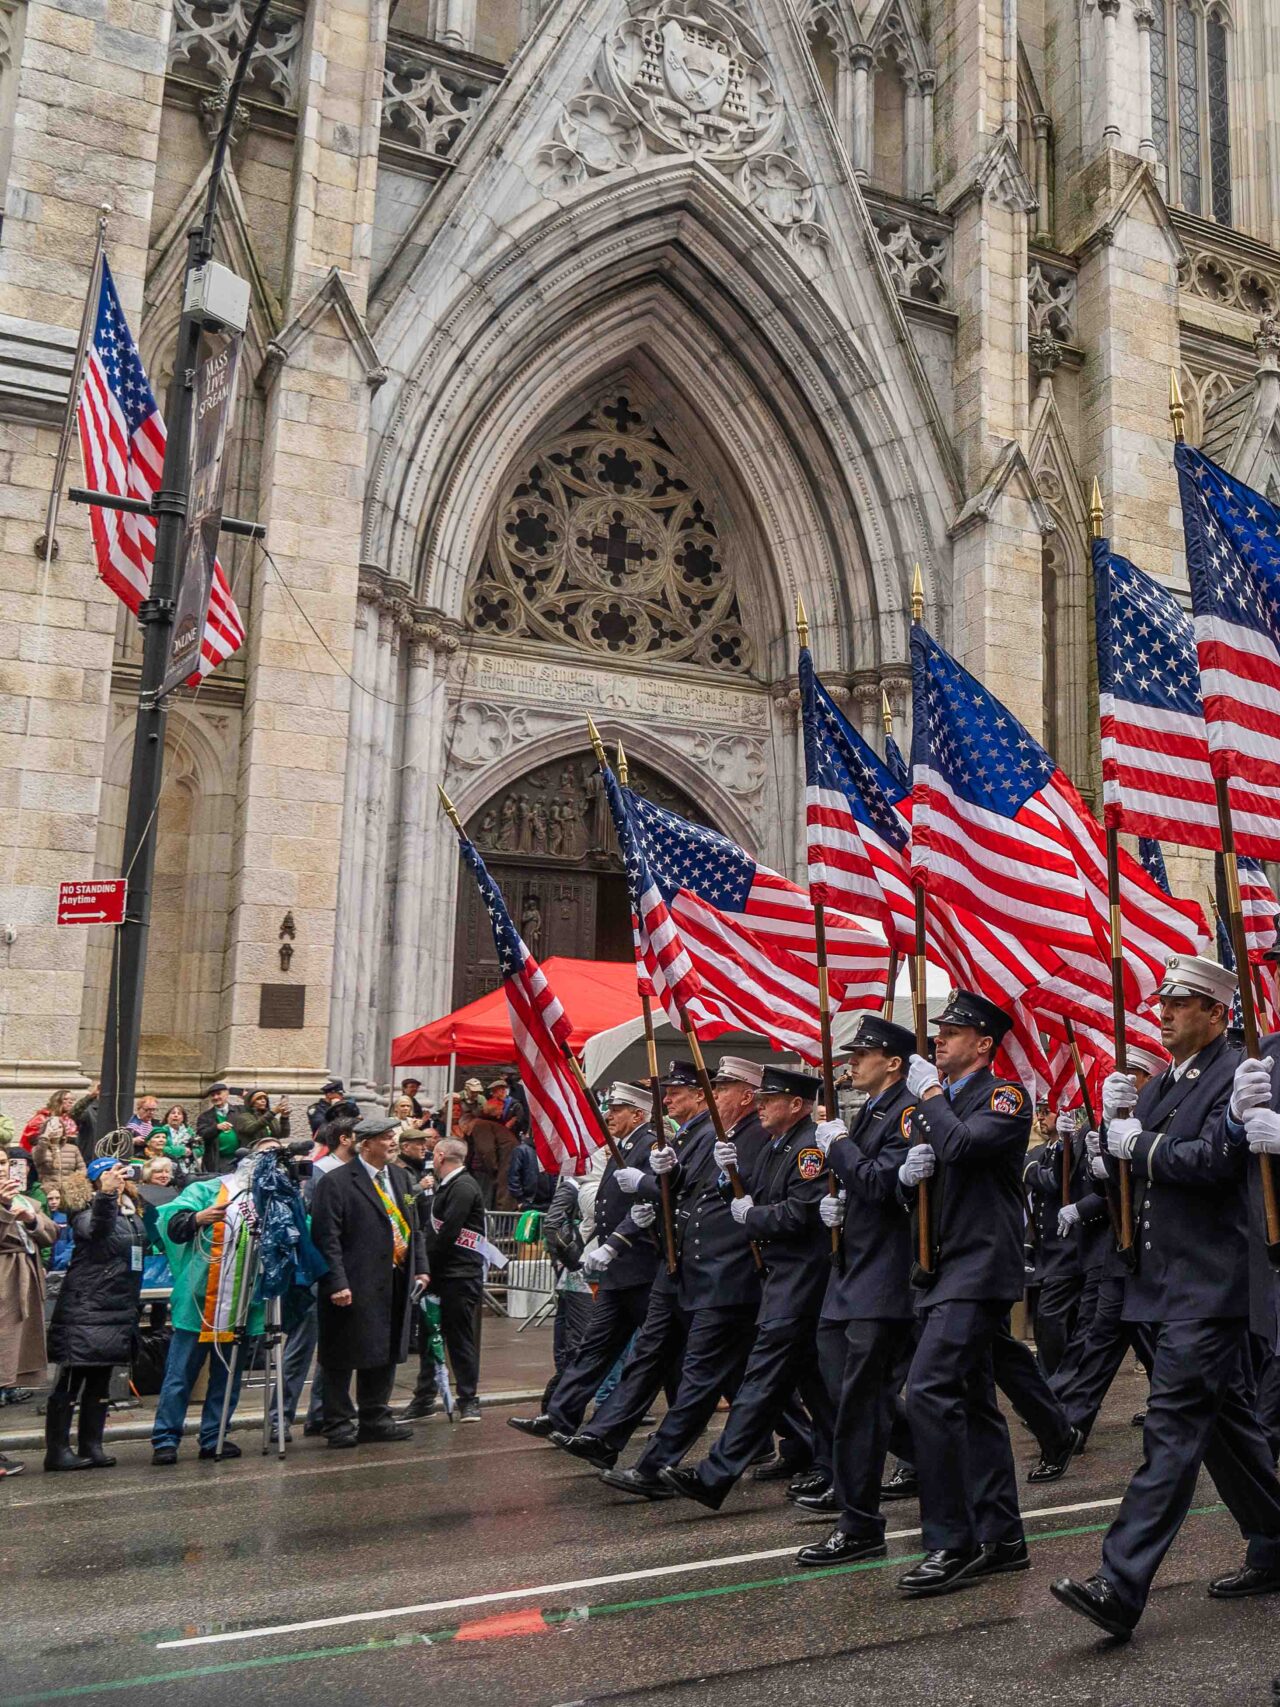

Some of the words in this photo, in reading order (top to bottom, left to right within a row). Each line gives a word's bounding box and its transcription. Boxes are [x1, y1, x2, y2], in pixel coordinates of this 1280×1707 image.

[206, 350, 228, 379] MASS
[206, 370, 225, 395] LIVE
[198, 383, 230, 419] STREAM
[62, 885, 74, 895] NO
[75, 884, 116, 894] STANDING
[62, 895, 96, 906] Anytime
